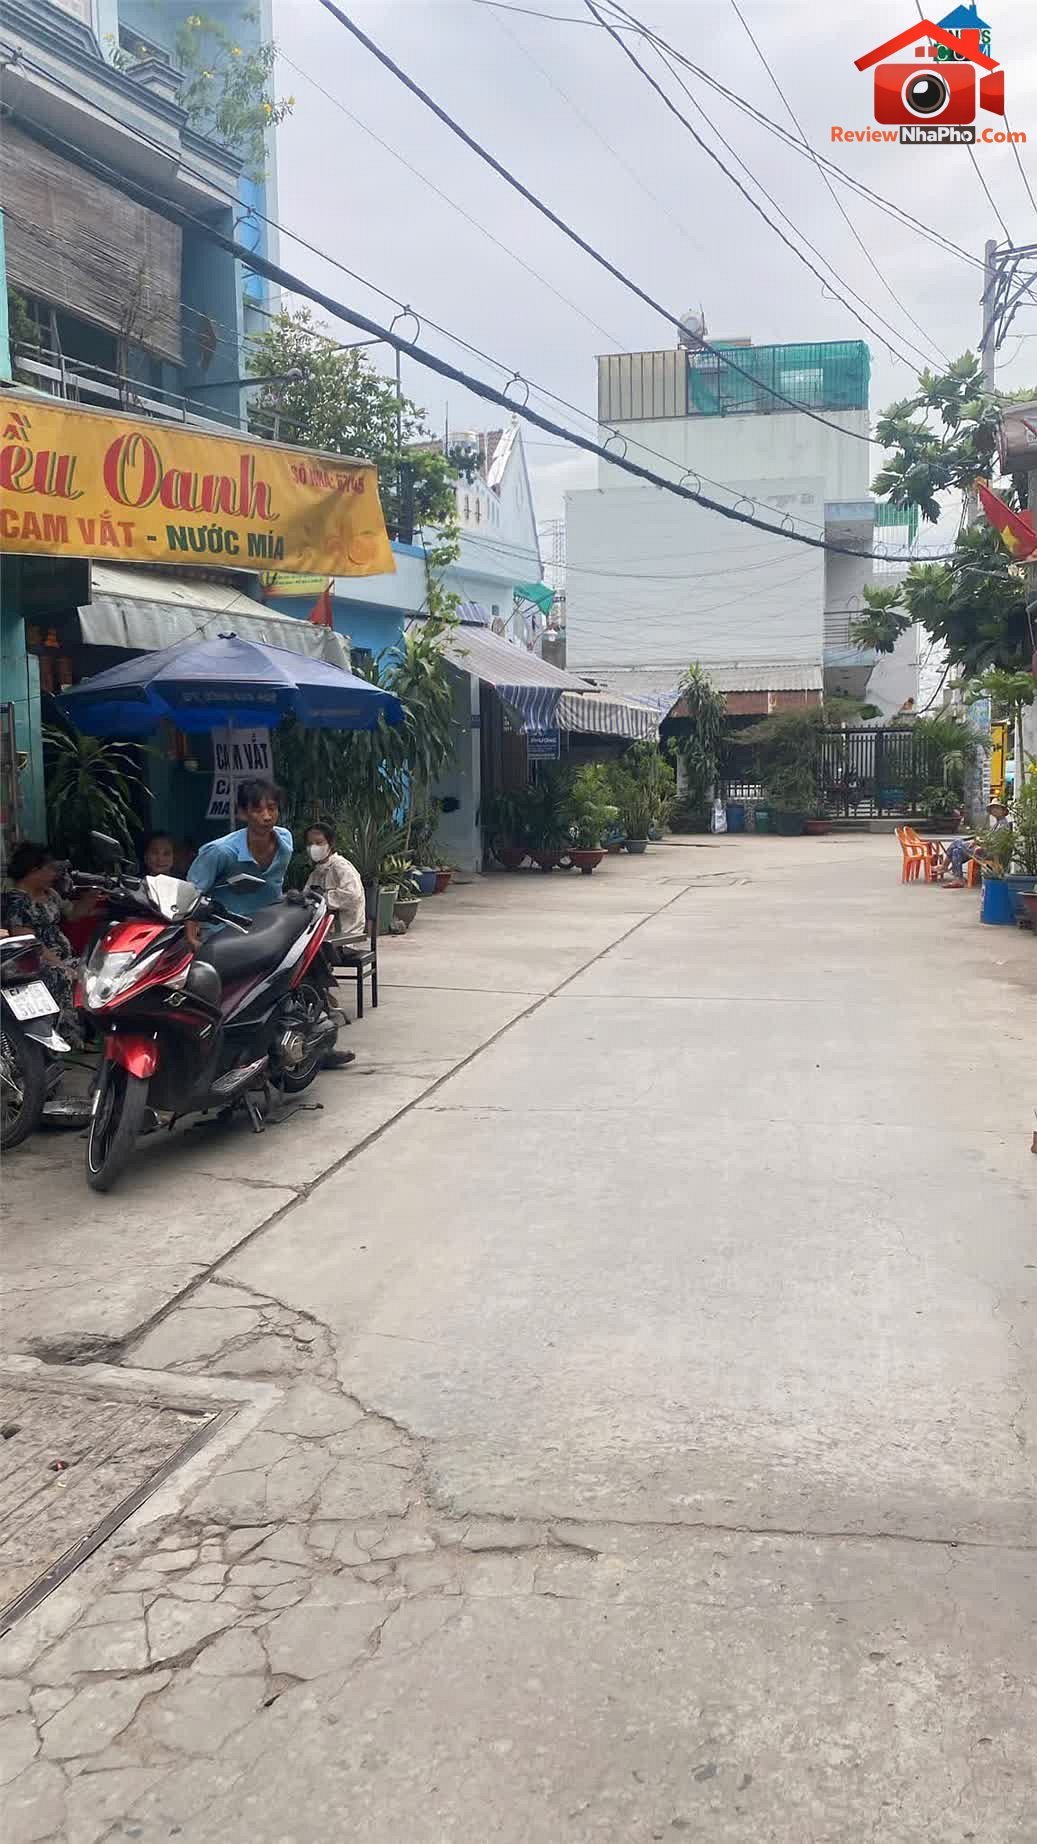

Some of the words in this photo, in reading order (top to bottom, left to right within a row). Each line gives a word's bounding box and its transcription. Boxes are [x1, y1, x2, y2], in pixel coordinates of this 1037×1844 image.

[103, 431, 280, 521] Oanh
[1, 508, 70, 544] CAM
[76, 509, 136, 547] VẮT
[167, 522, 240, 555] NƯỚC
[247, 529, 285, 561] MÍA
